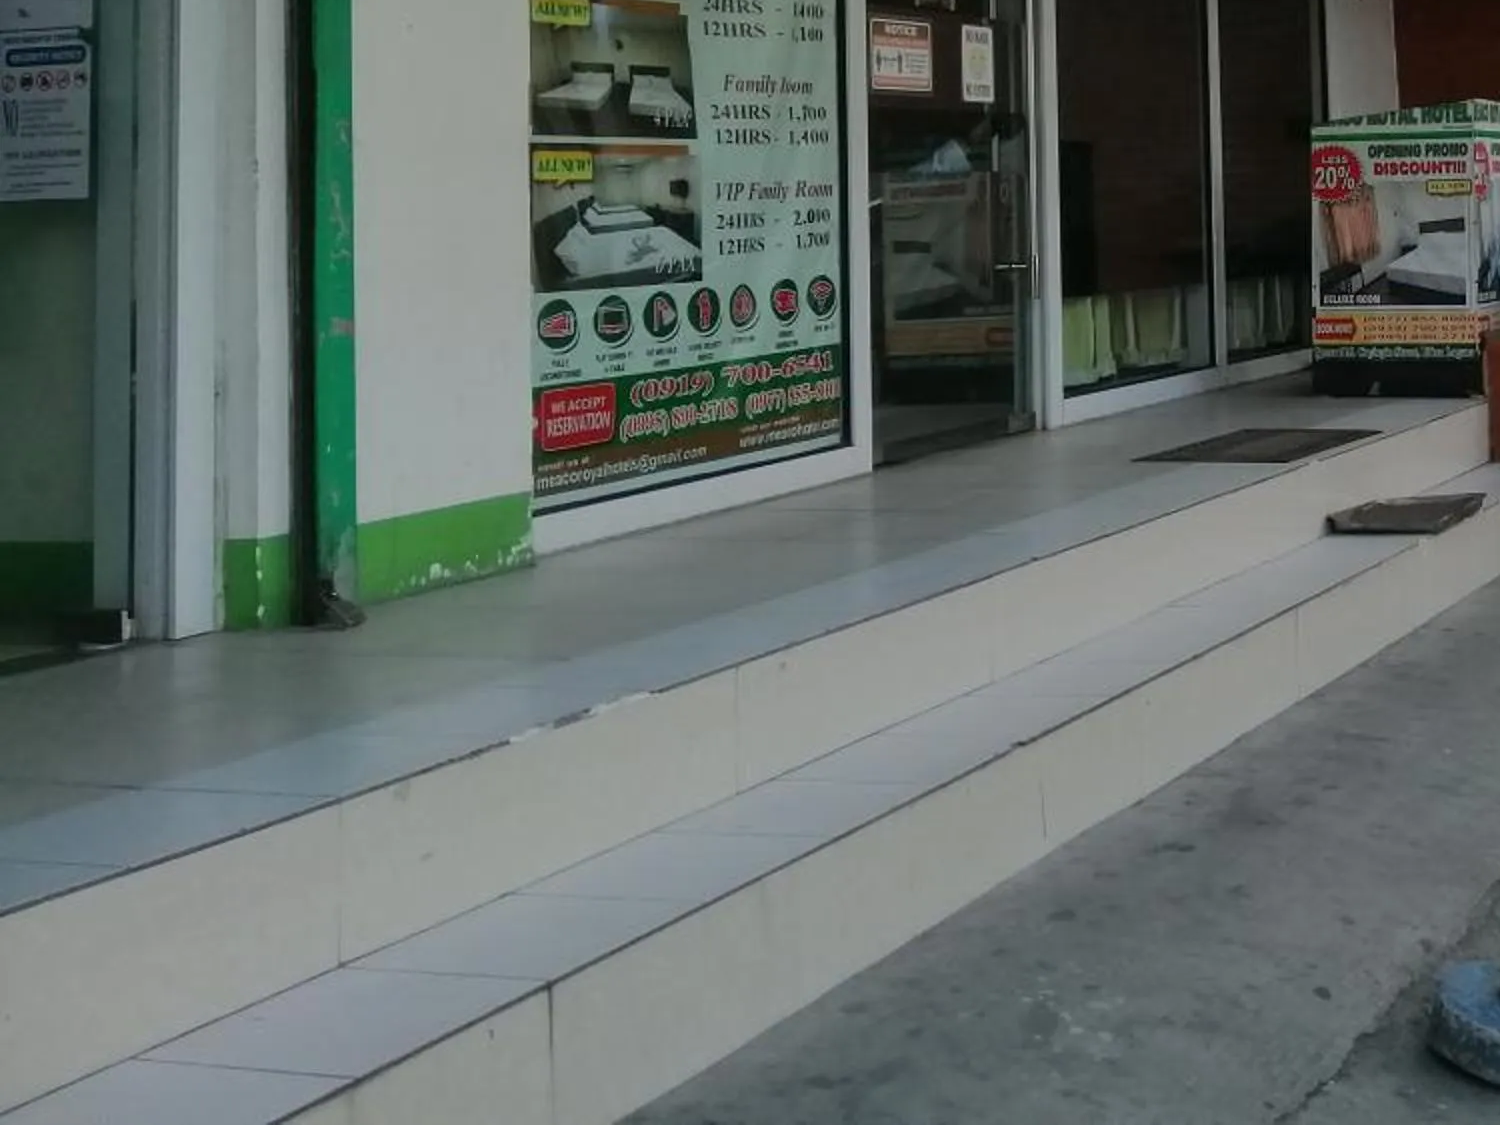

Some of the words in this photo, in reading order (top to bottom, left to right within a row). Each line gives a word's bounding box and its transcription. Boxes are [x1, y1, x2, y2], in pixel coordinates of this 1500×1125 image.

[703, 21, 767, 39] 12HRS
[723, 74, 777, 97] Family
[711, 104, 770, 121] 24HRS
[1421, 100, 1472, 124] HOTEL
[716, 129, 771, 146] 12HRS
[1367, 144, 1421, 158] OPENING
[1425, 143, 1468, 156] PROMO
[1373, 160, 1467, 175] DISCOUNT!!!
[1315, 165, 1356, 190] 20%
[716, 181, 744, 200] VIP
[716, 213, 765, 231] 24HRS
[718, 236, 765, 256] 12HRS
[567, 396, 607, 411] ACCEPT
[546, 411, 612, 438] RESERVATION
